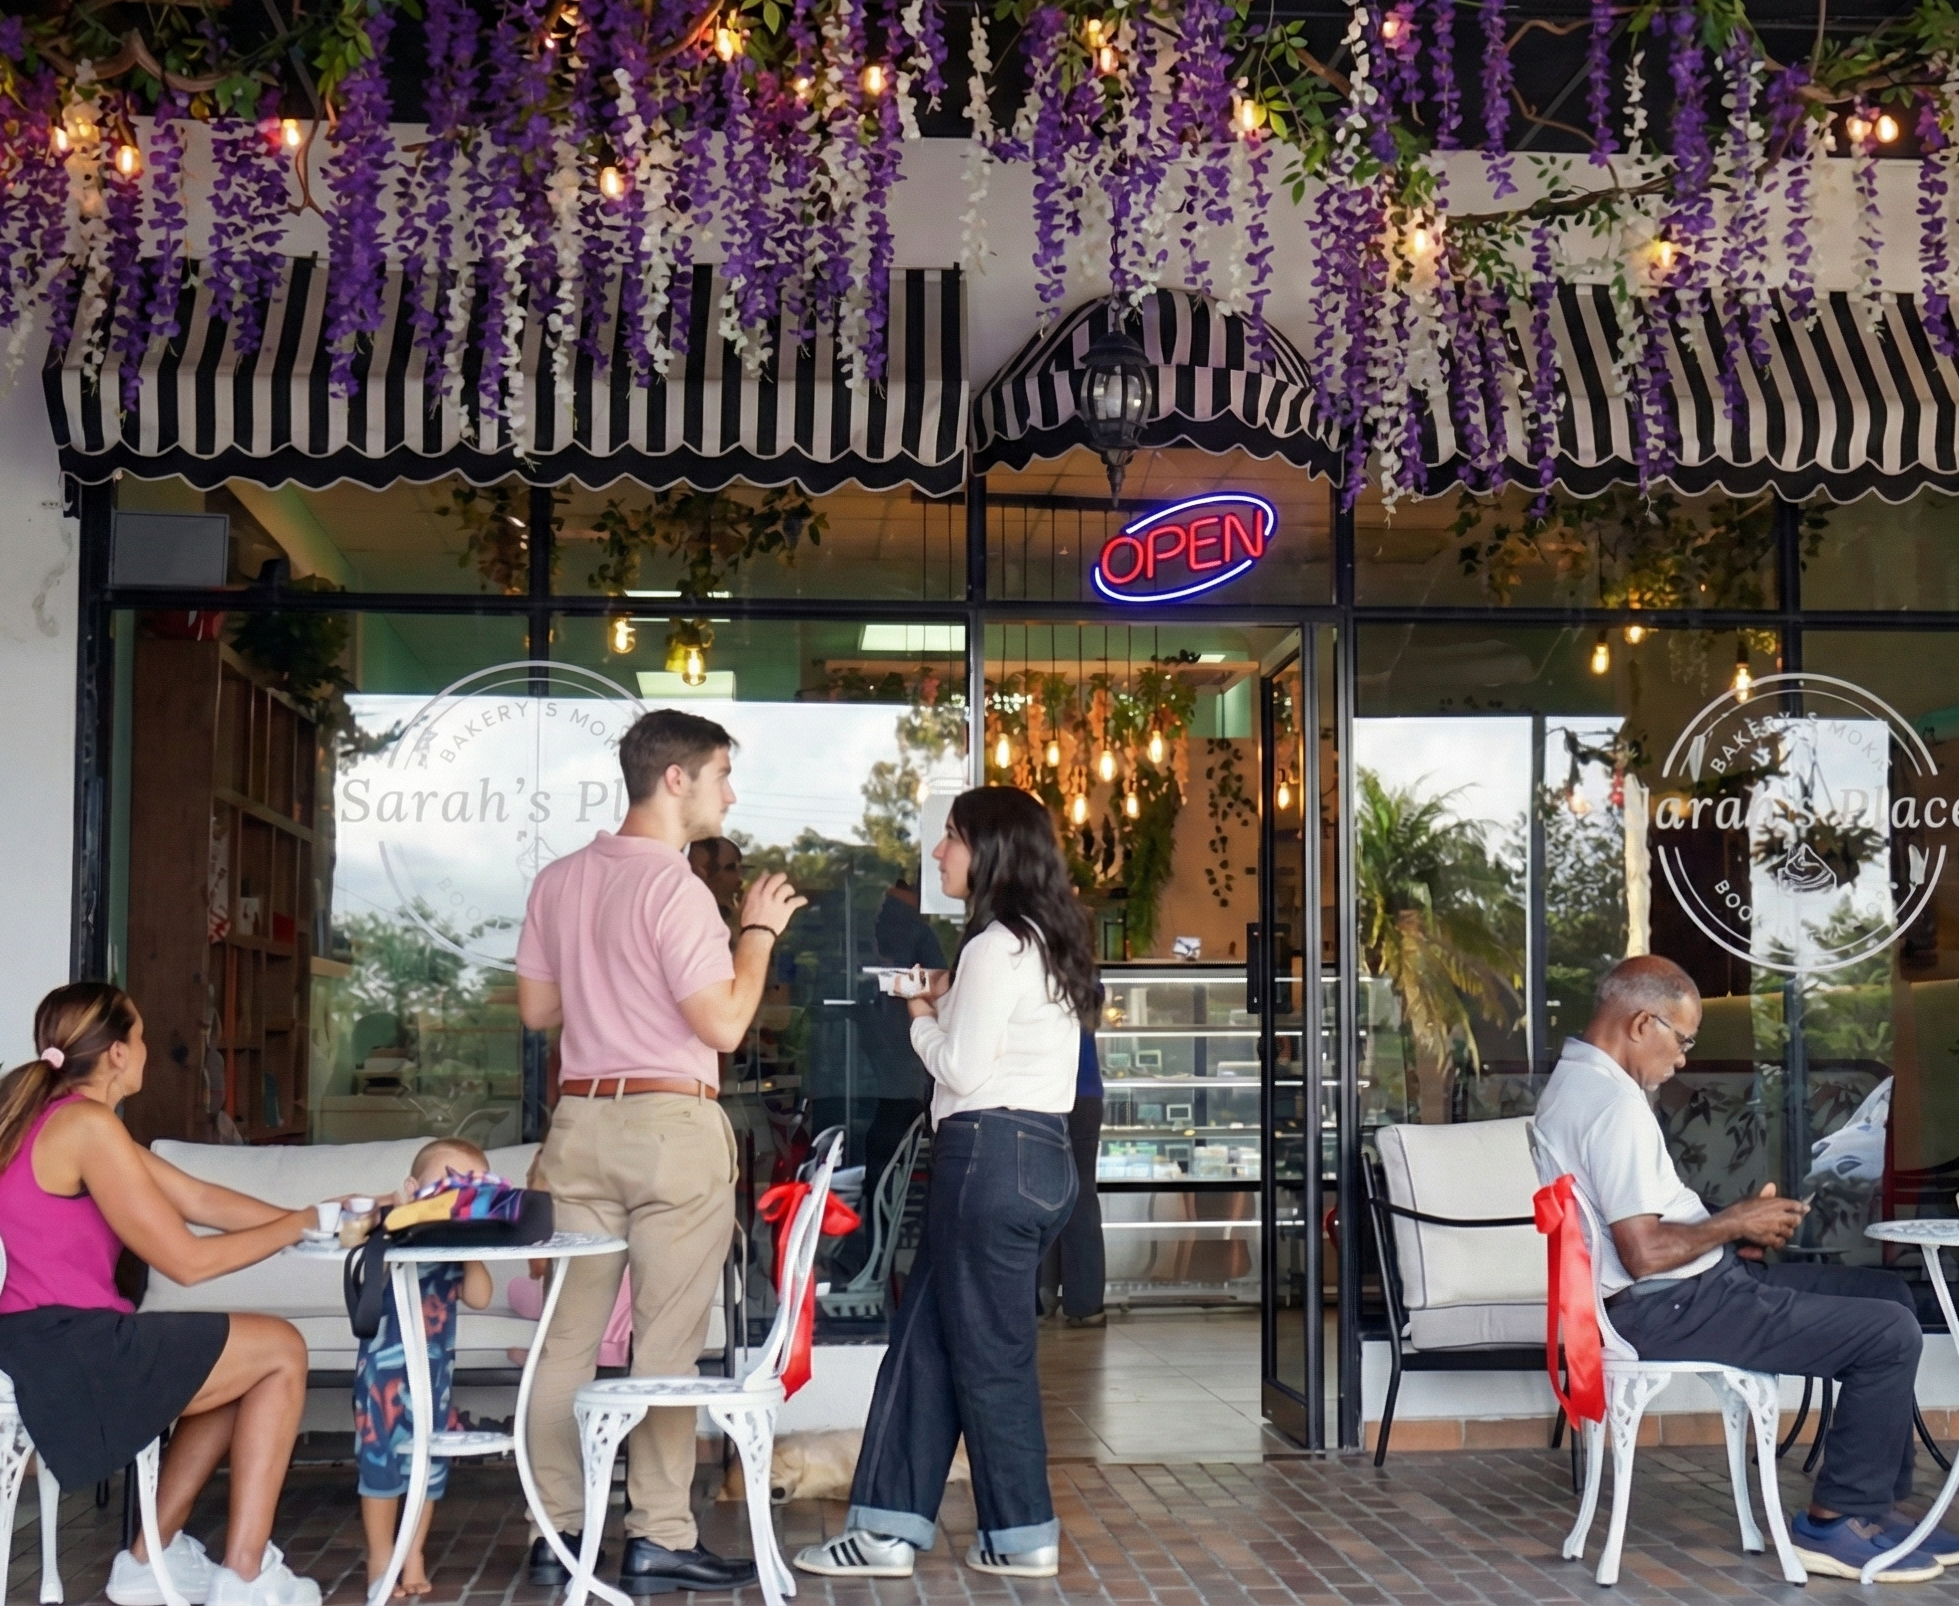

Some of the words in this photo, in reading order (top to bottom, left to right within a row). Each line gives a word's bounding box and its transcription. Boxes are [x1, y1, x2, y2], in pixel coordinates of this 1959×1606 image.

[1100, 507, 1265, 584] OPEN
[439, 700, 529, 763] BAKERY
[569, 708, 621, 756] MOK
[1710, 711, 1791, 774] BAKERY
[340, 777, 551, 823] Sarah's
